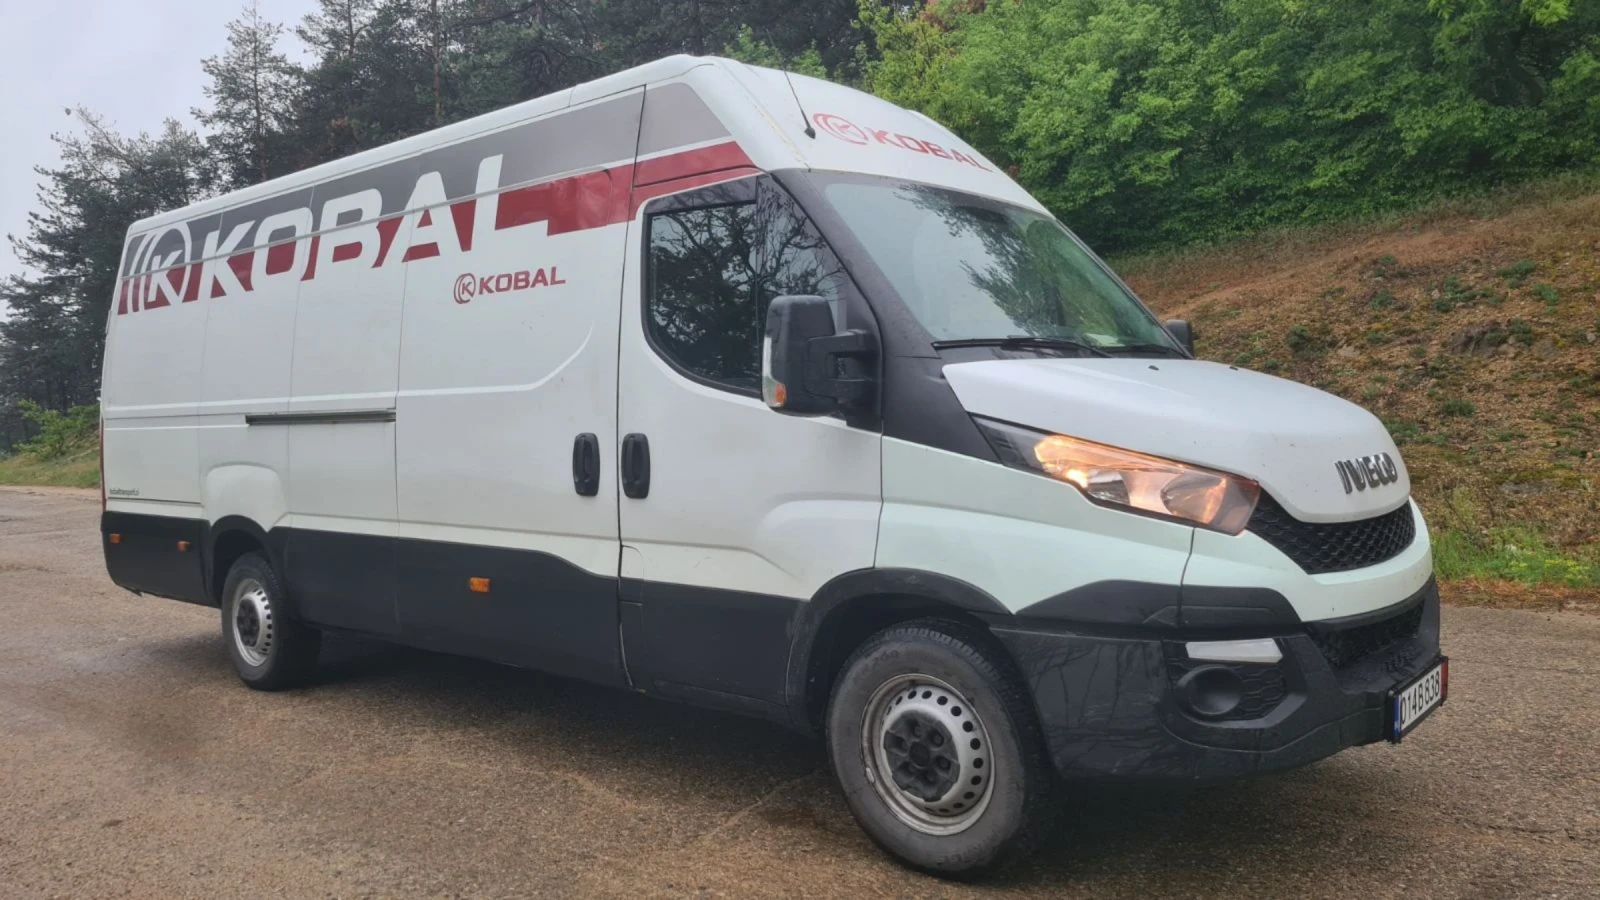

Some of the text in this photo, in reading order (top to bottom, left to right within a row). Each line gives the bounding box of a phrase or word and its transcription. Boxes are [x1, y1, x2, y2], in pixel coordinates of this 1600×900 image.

[864, 126, 993, 172] KOBAL
[201, 153, 549, 300] KOBAL
[478, 266, 566, 295] KOBAL
[1334, 452, 1398, 494] IVECO
